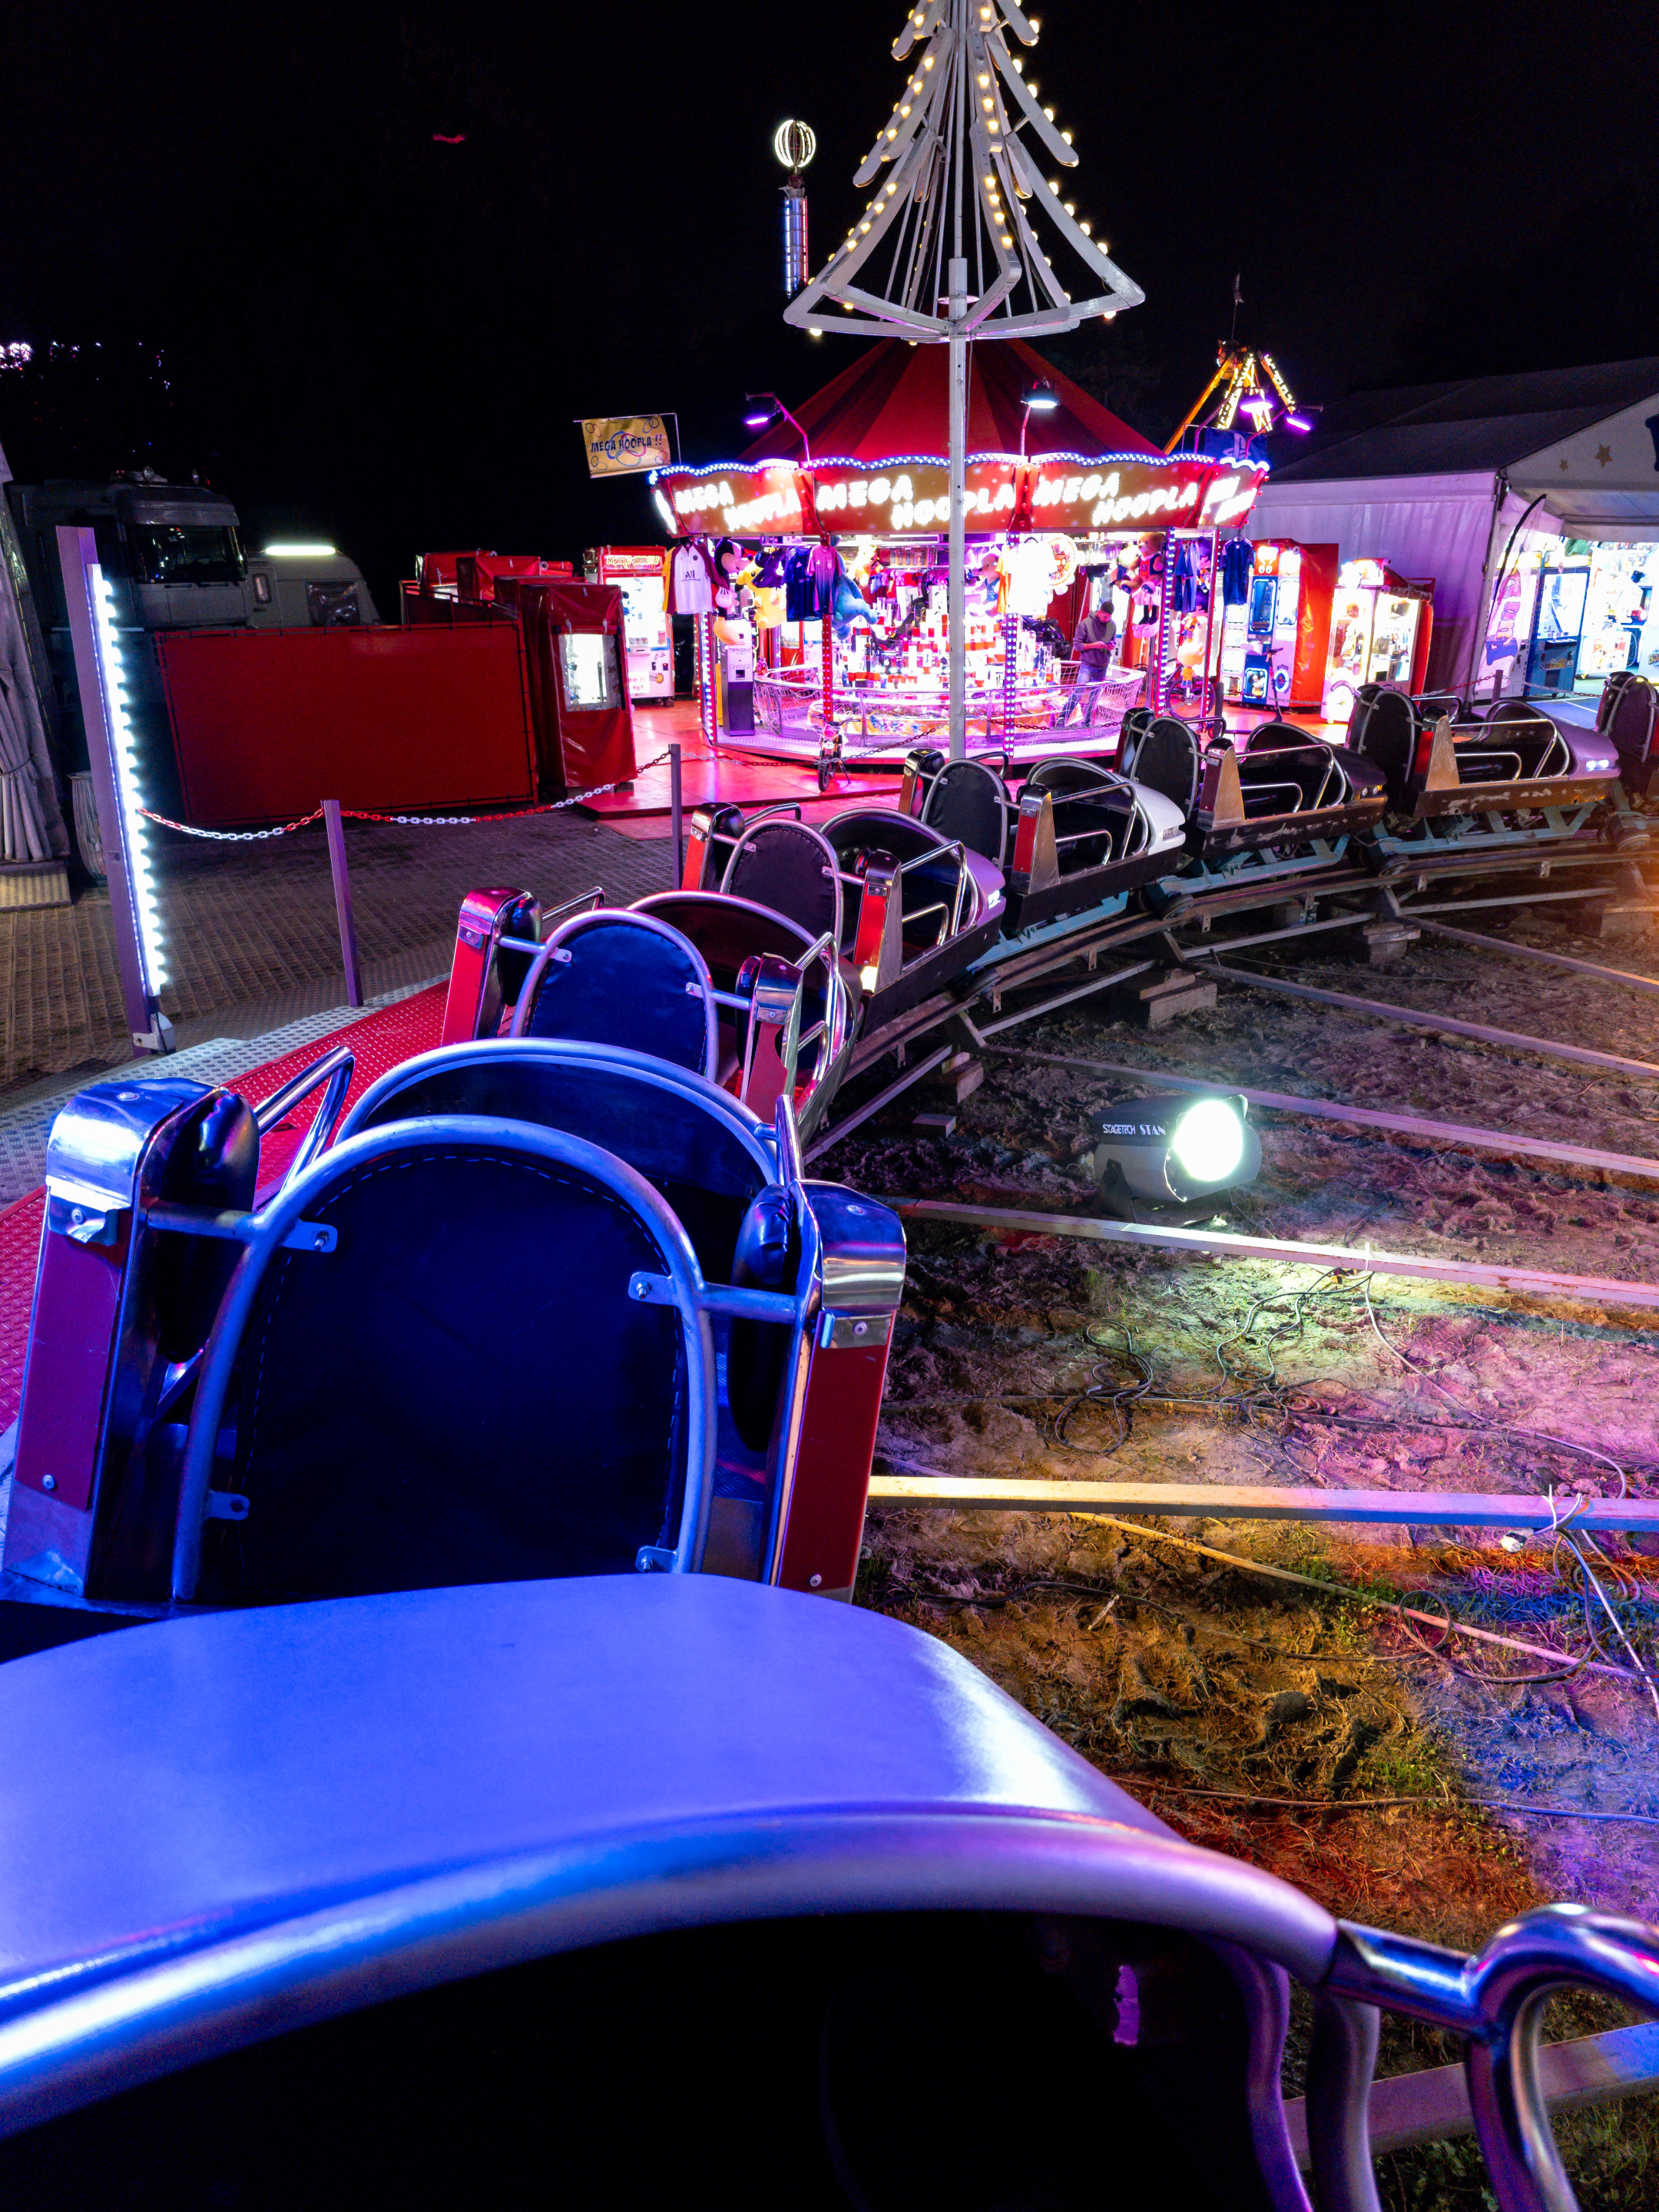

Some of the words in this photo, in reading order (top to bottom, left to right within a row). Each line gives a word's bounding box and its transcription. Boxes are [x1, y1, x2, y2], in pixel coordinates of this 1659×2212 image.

[591, 441, 616, 453] MEGA
[618, 436, 652, 449] HOOPLA
[816, 475, 914, 512] MEGA
[891, 484, 1016, 530] HOOPLA
[1032, 472, 1120, 506] MEGA
[1092, 482, 1197, 526] HOOPLA
